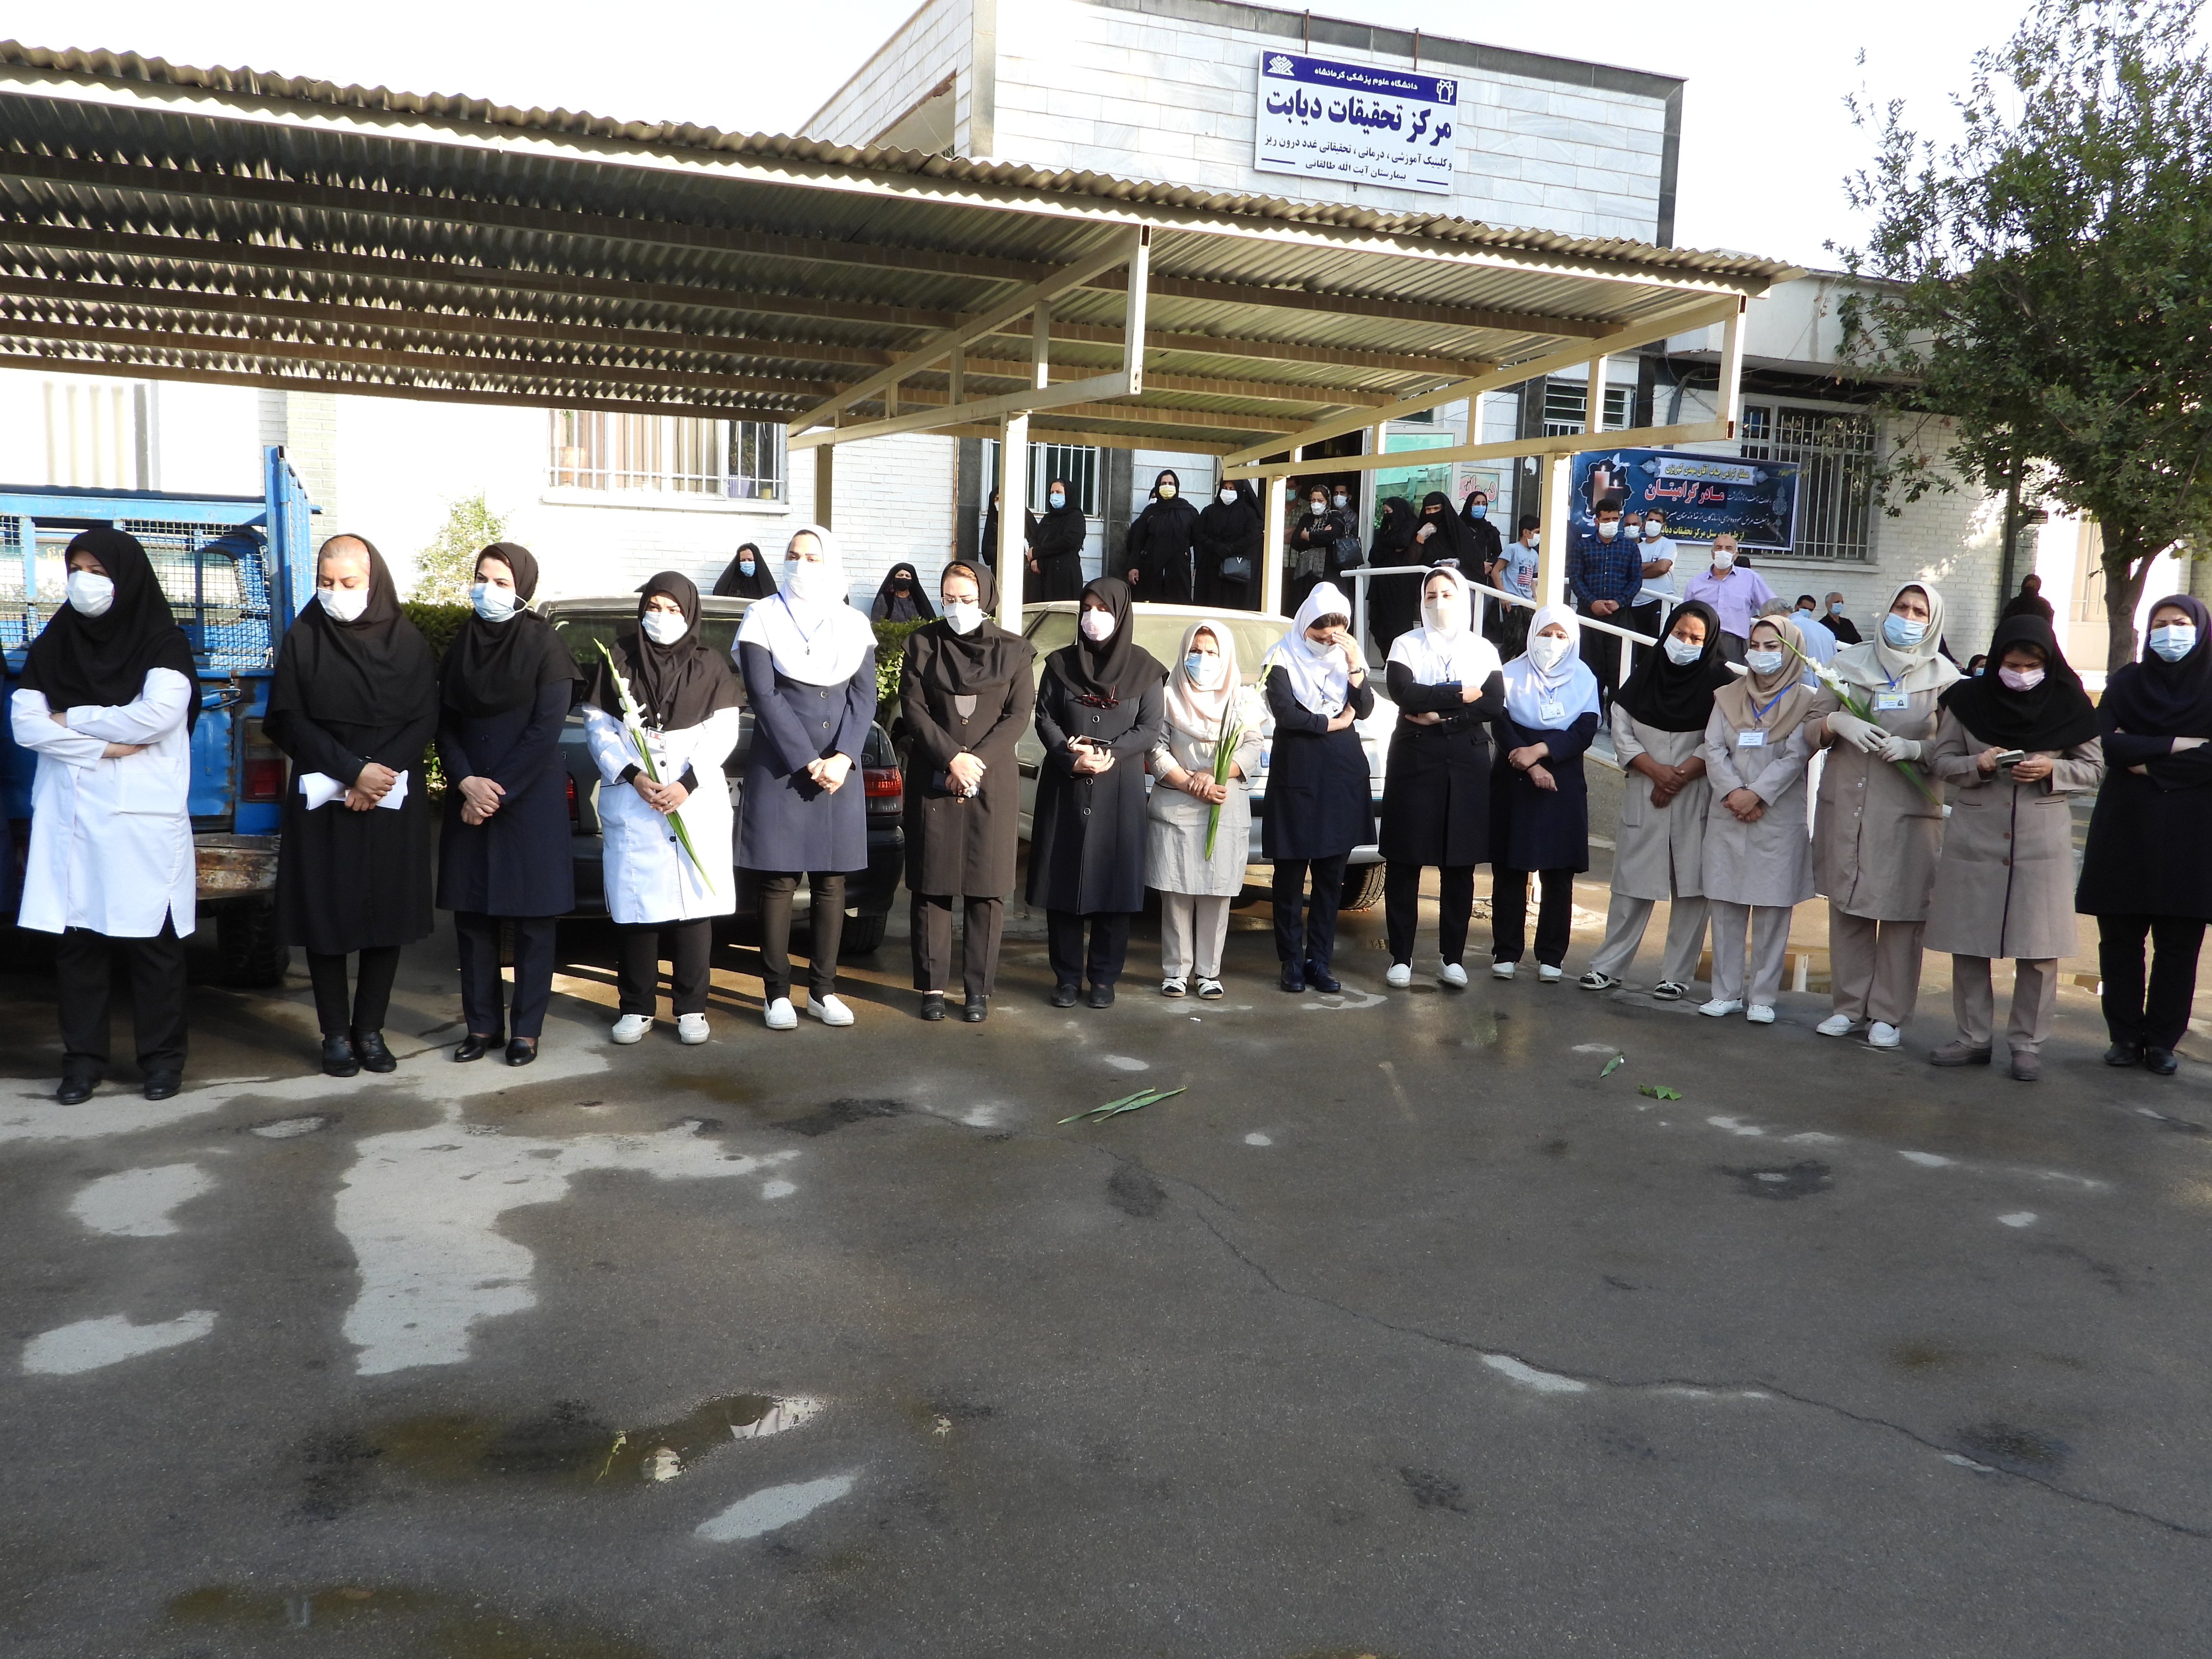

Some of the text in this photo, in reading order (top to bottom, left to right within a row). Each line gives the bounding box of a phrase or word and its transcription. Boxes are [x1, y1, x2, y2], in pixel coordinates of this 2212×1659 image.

[1314, 67, 1418, 90] دانشگاه علوم پزشکی کرمانشاه
[1266, 87, 1452, 146] مرکز تحقیقات دیابت
[1264, 134, 1277, 146] ریز
[1279, 137, 1300, 149] درون
[1302, 140, 1317, 148] غدد
[1319, 141, 1352, 155] تحقیقاتی
[1358, 146, 1384, 161] درمانی
[1392, 151, 1422, 166] آموزشی
[1423, 156, 1447, 169] کلینیک
[1305, 158, 1407, 182] بیمارستان آیت الله طالقانی
[1447, 163, 1452, 171] و
[1683, 465, 1696, 476] مهدی
[1697, 464, 1709, 477] آقای
[1709, 466, 1721, 479] جناب
[1721, 467, 1736, 481] گرامی
[1645, 478, 1725, 504] مادر گرامیتان
[1661, 525, 1672, 536] دیاب
[1672, 526, 1693, 537] تحقیقات
[1693, 528, 1706, 539] مرکز
[1739, 531, 1744, 541] از
